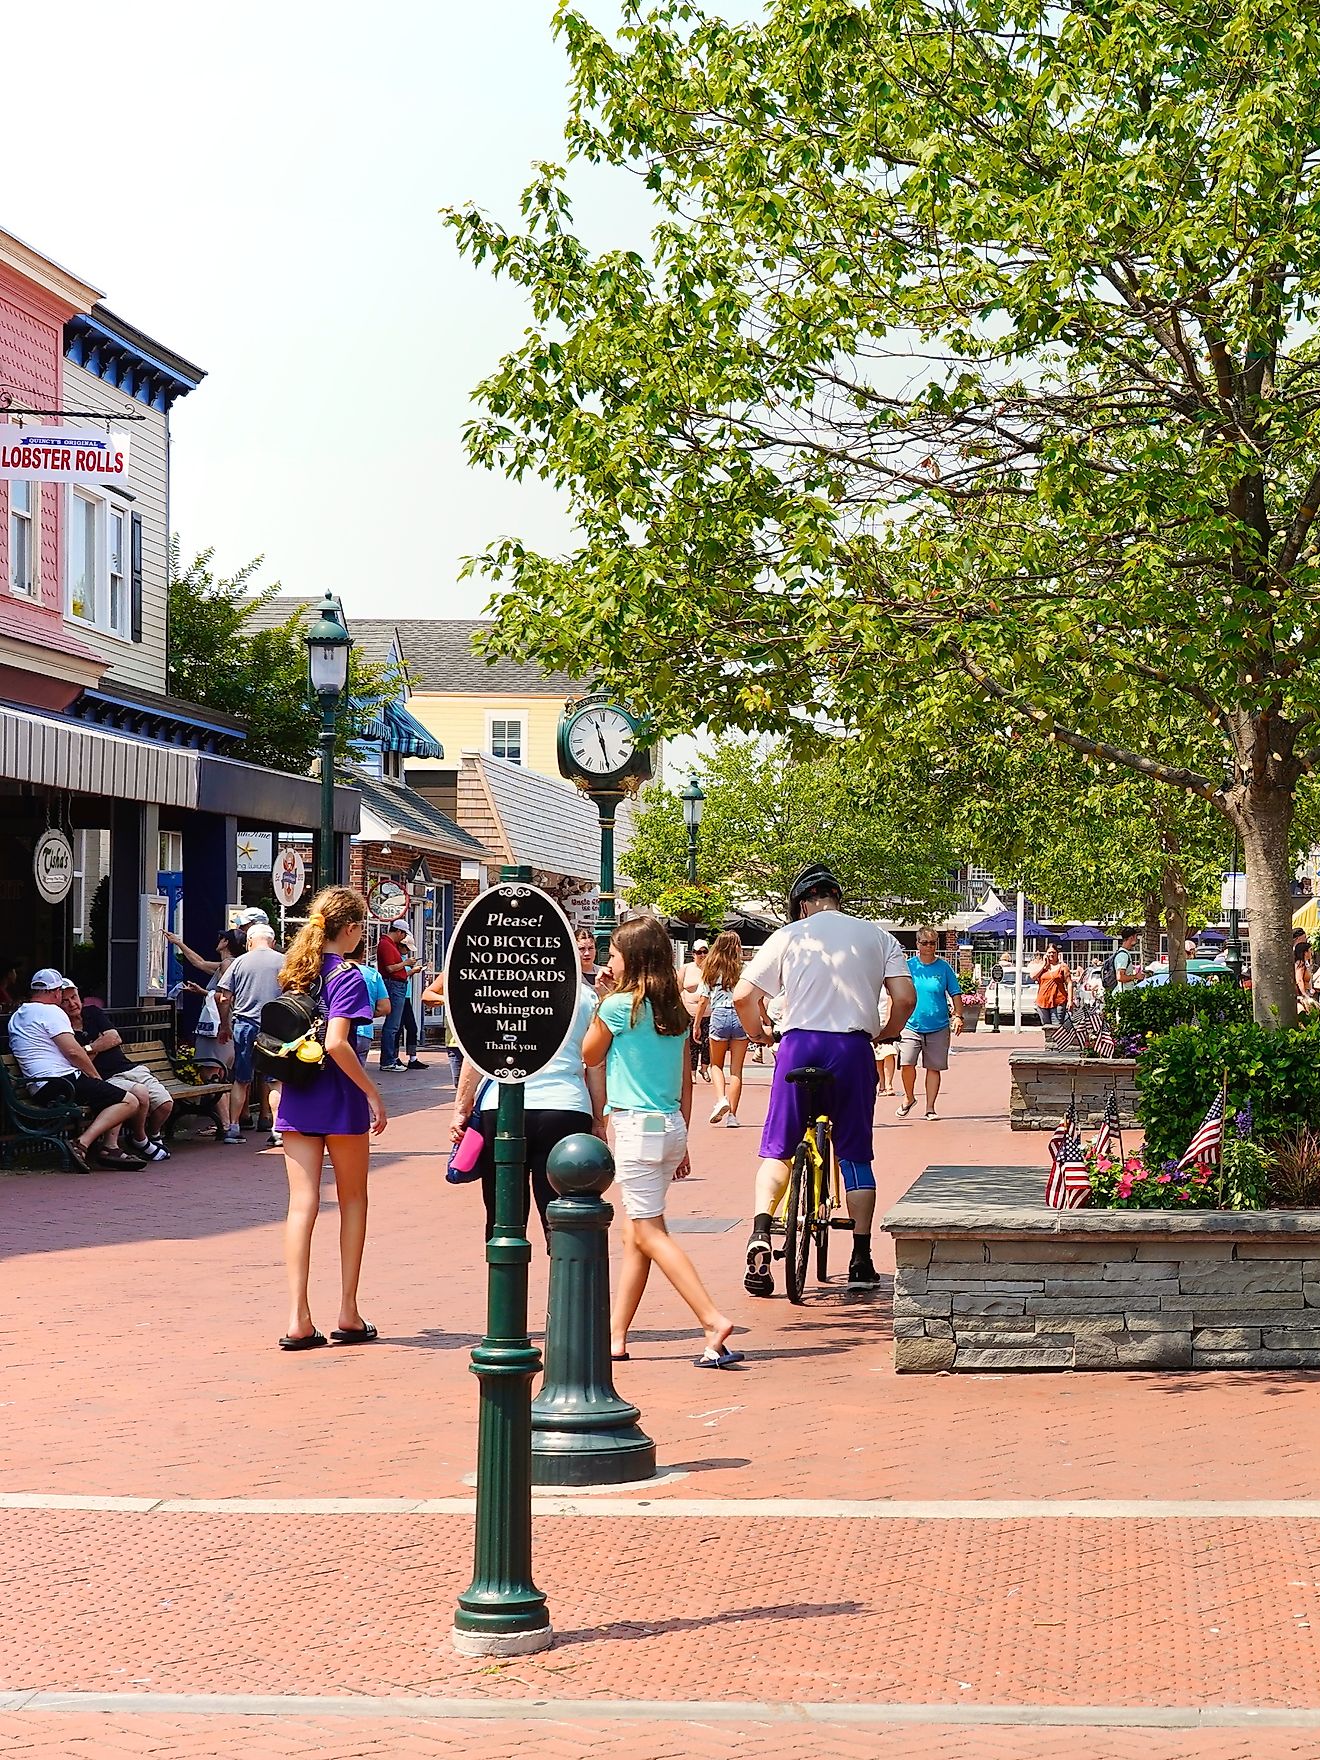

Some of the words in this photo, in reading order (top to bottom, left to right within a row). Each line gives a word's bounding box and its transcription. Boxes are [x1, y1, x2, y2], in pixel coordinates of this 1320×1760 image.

[2, 446, 70, 470] LOBSTER
[76, 450, 123, 473] ROLLS
[487, 913, 543, 927] Please!
[466, 935, 489, 947] NO
[493, 936, 561, 948] BICYCLES
[470, 952, 493, 964] NO
[496, 953, 538, 965] DOGS
[541, 956, 556, 965] or
[460, 969, 566, 982] SKATEBOARDS
[474, 986, 528, 998] allowed
[532, 989, 550, 998] on
[471, 1003, 553, 1018] Washington
[496, 1020, 527, 1031] Mall
[485, 1041, 517, 1051] Thank
[519, 1044, 537, 1053] you
